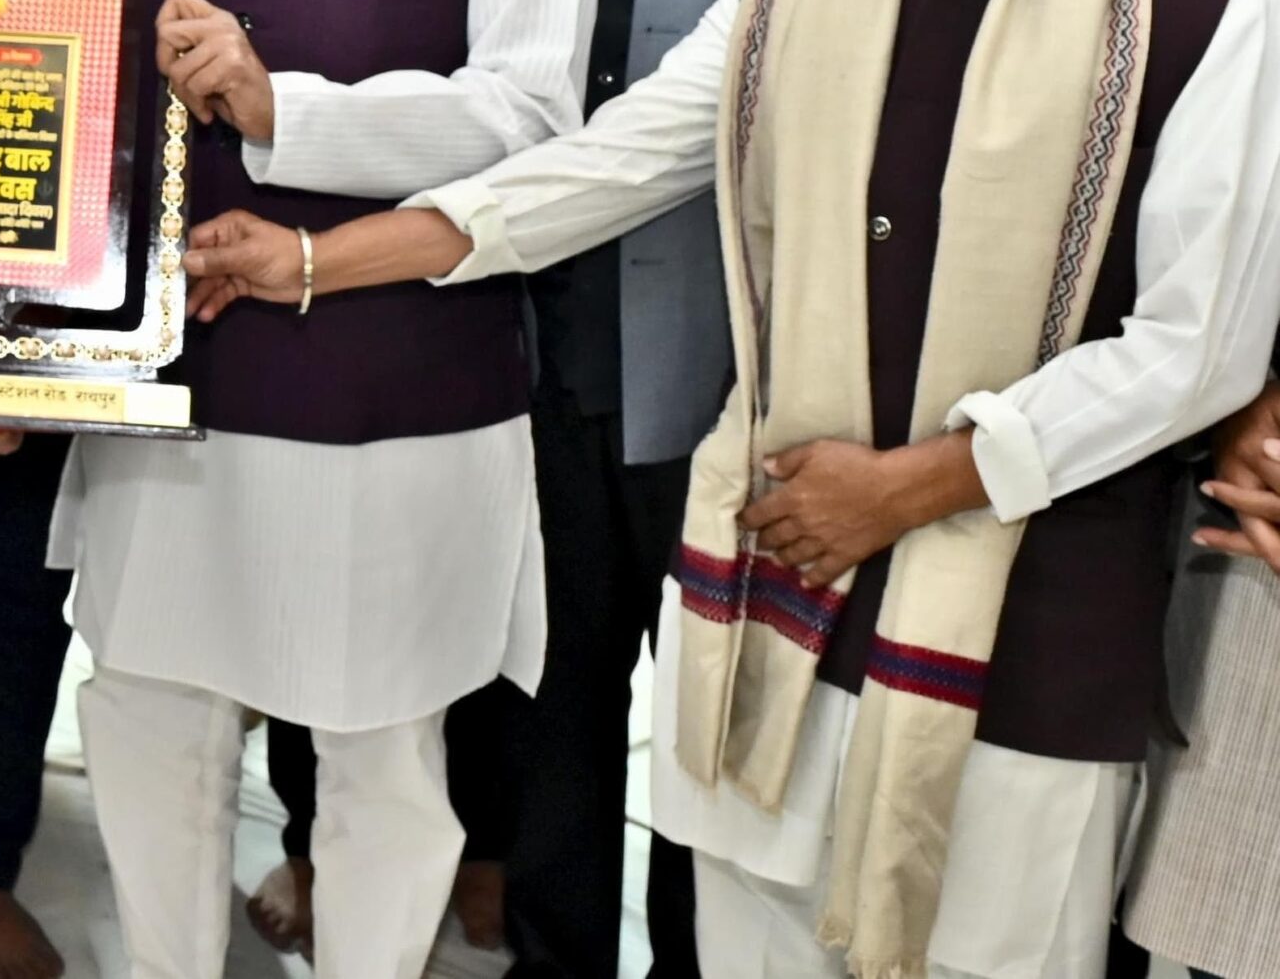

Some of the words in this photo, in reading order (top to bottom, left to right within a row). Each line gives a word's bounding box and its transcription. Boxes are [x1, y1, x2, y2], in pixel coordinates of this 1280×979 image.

[4, 147, 53, 172] बाल
[43, 383, 66, 401] रोड
[75, 390, 116, 409] रायपुर
